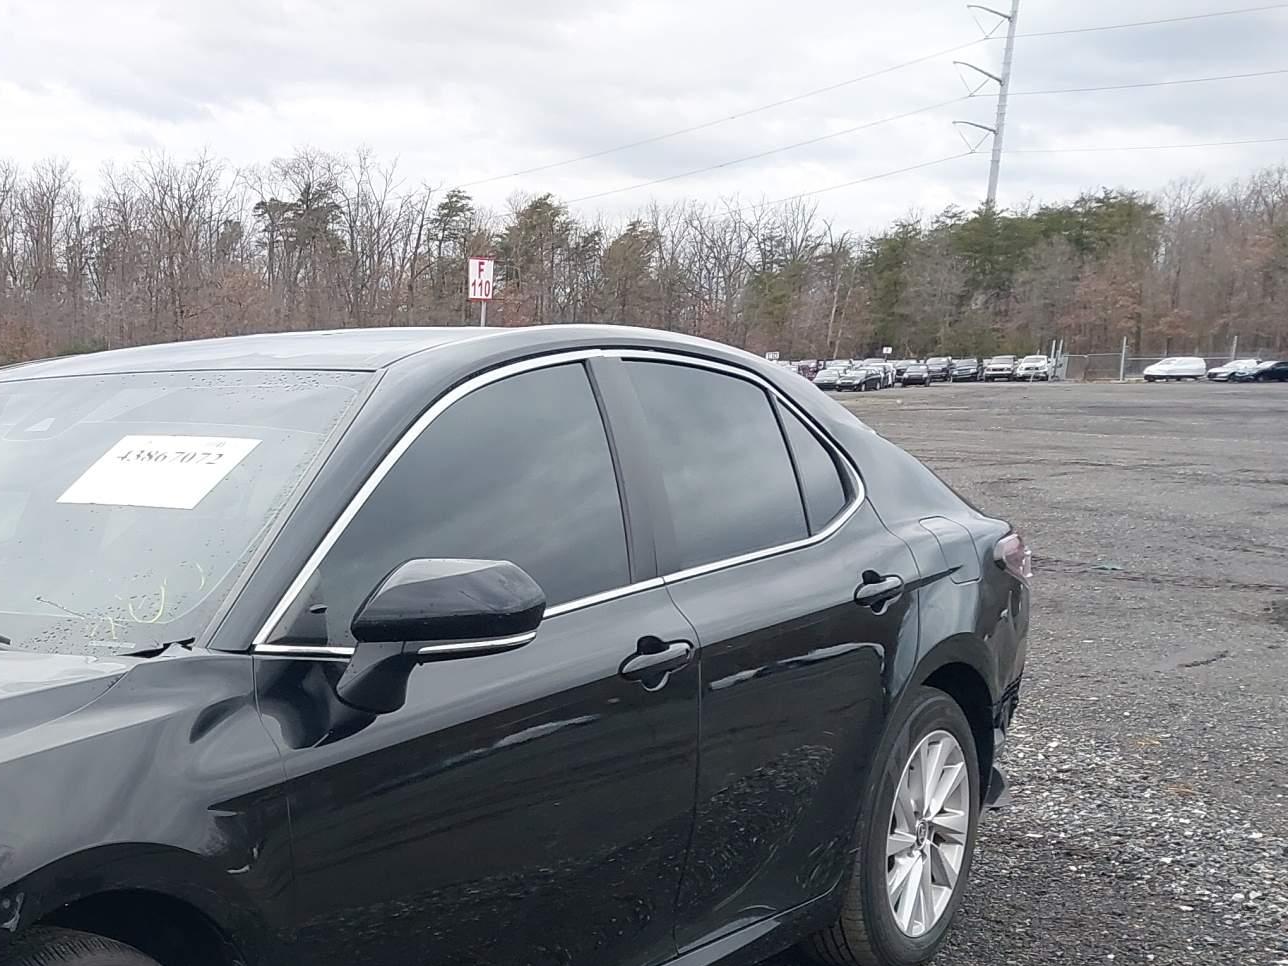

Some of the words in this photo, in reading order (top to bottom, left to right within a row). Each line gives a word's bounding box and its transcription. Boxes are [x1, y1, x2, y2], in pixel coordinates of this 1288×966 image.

[478, 262, 485, 278] F
[471, 280, 491, 297] 110
[117, 450, 224, 465] 43867072
